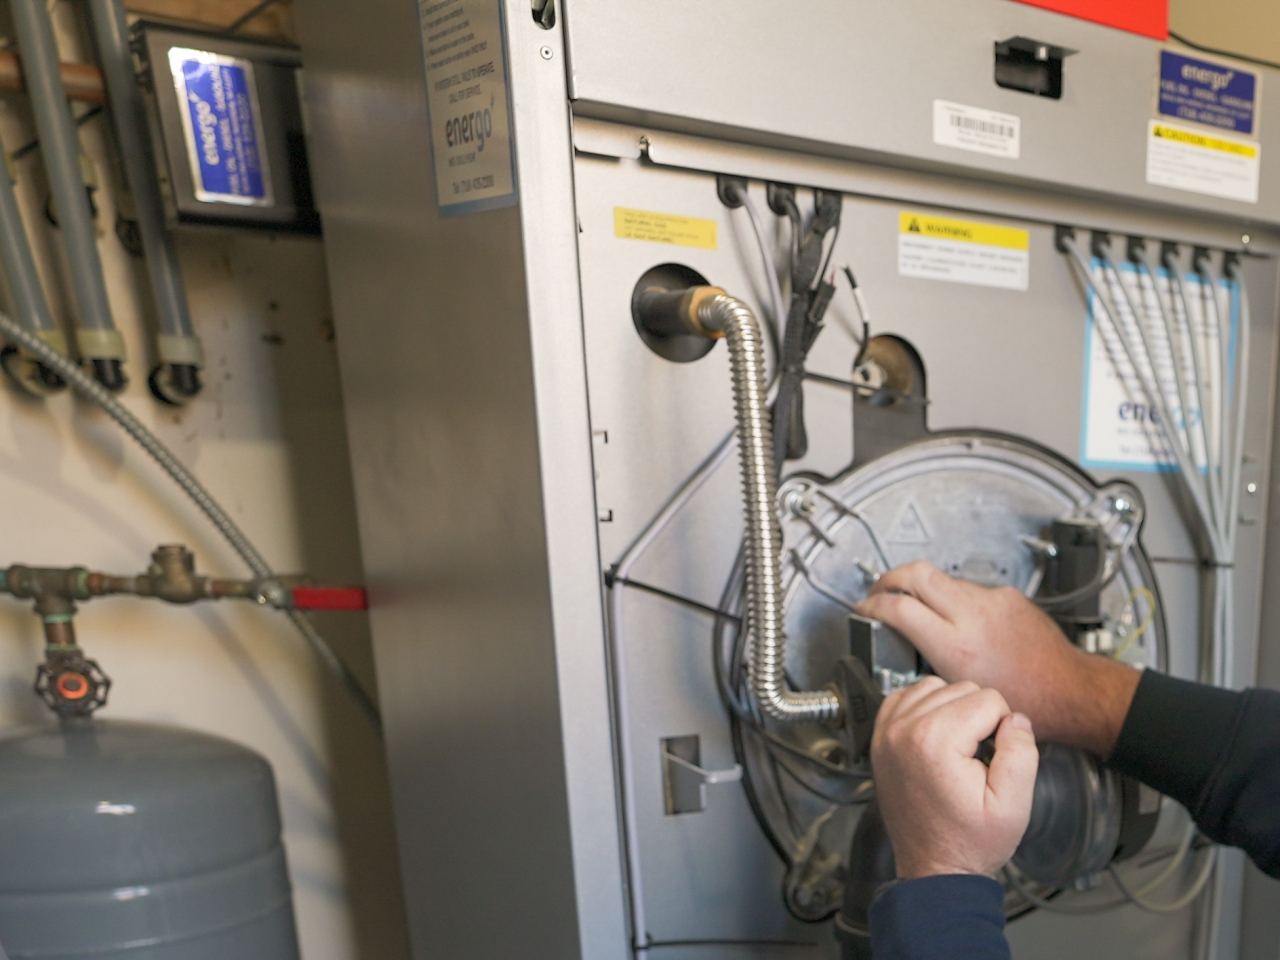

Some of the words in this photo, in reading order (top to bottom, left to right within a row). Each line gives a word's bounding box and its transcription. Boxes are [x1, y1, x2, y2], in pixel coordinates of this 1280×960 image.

[1181, 64, 1230, 92] energo
[195, 100, 220, 166] energo
[446, 108, 492, 152] energo
[926, 222, 974, 239] WARNING
